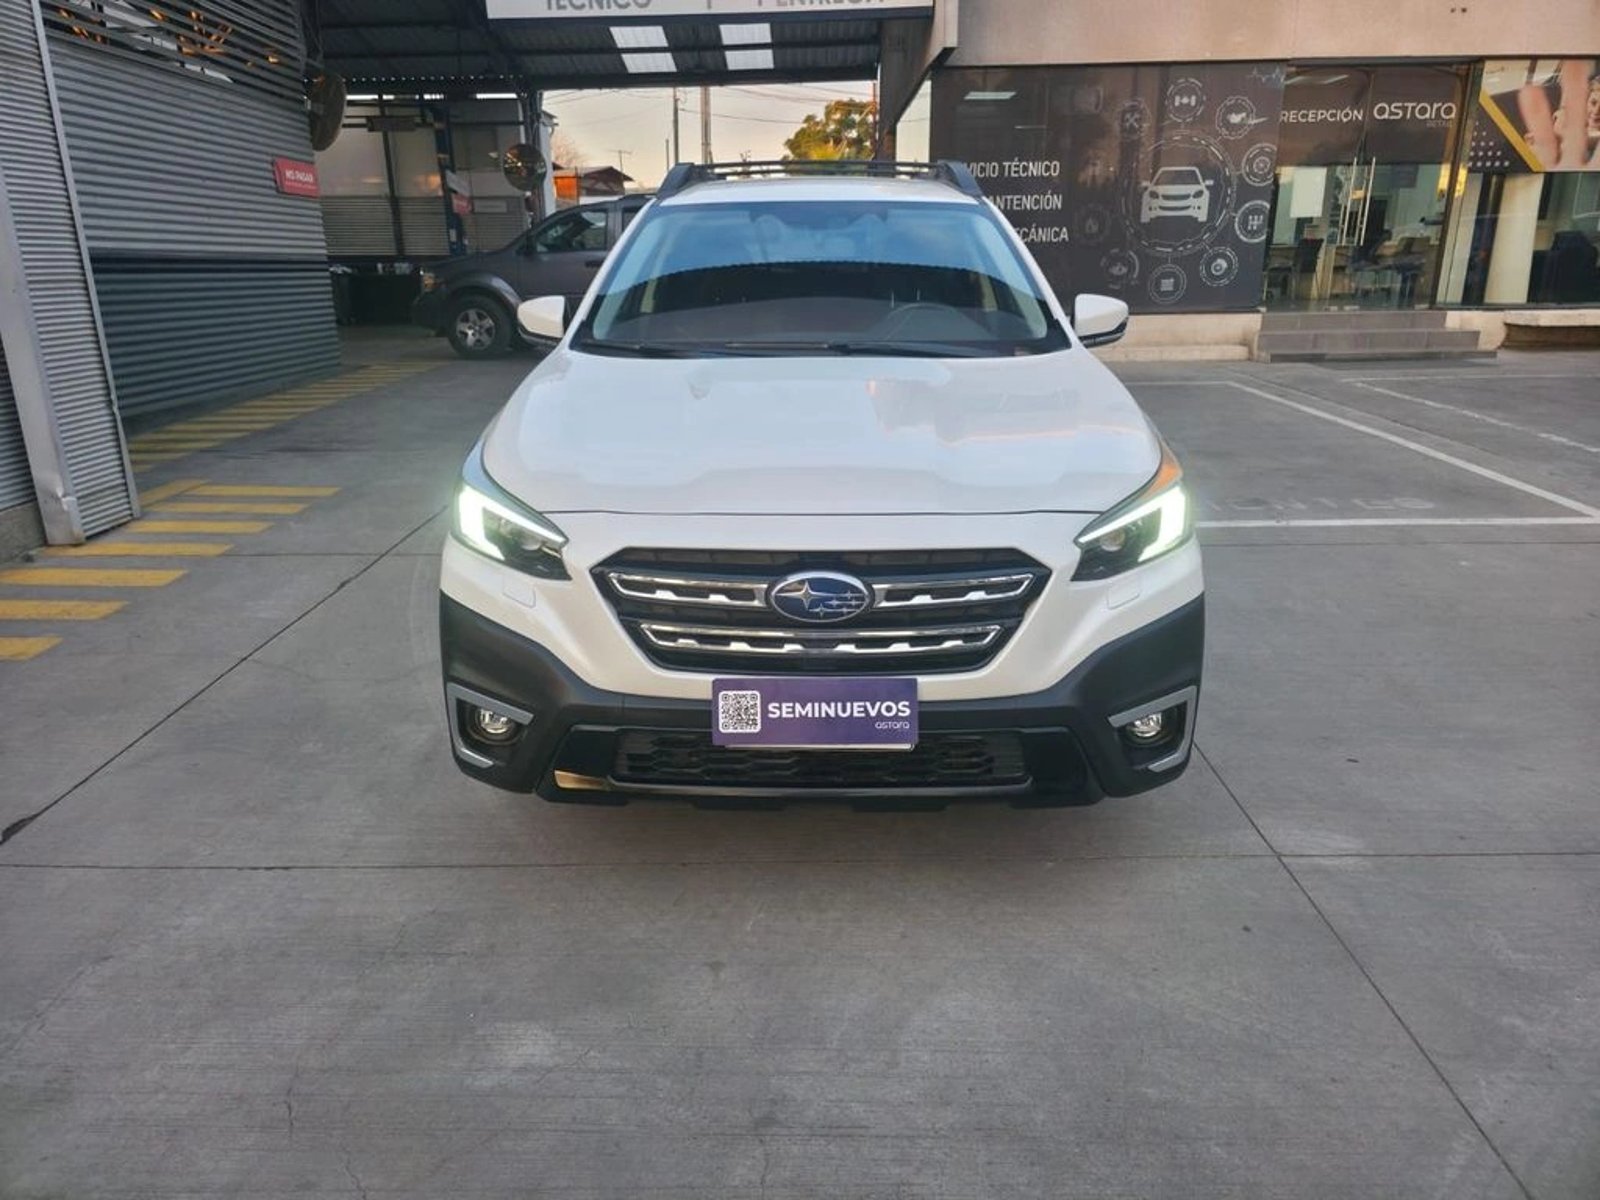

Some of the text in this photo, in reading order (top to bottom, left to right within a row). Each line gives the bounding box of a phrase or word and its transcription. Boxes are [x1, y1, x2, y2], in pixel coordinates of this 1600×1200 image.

[1279, 106, 1364, 123] RECEPCIÓN
[1373, 102, 1457, 120] astara
[967, 156, 1060, 178] VICIO TÉCNICO
[987, 189, 1063, 211] ANTENCIÓN
[768, 701, 911, 718] SEMINUEVOS
[875, 721, 910, 730] astara
